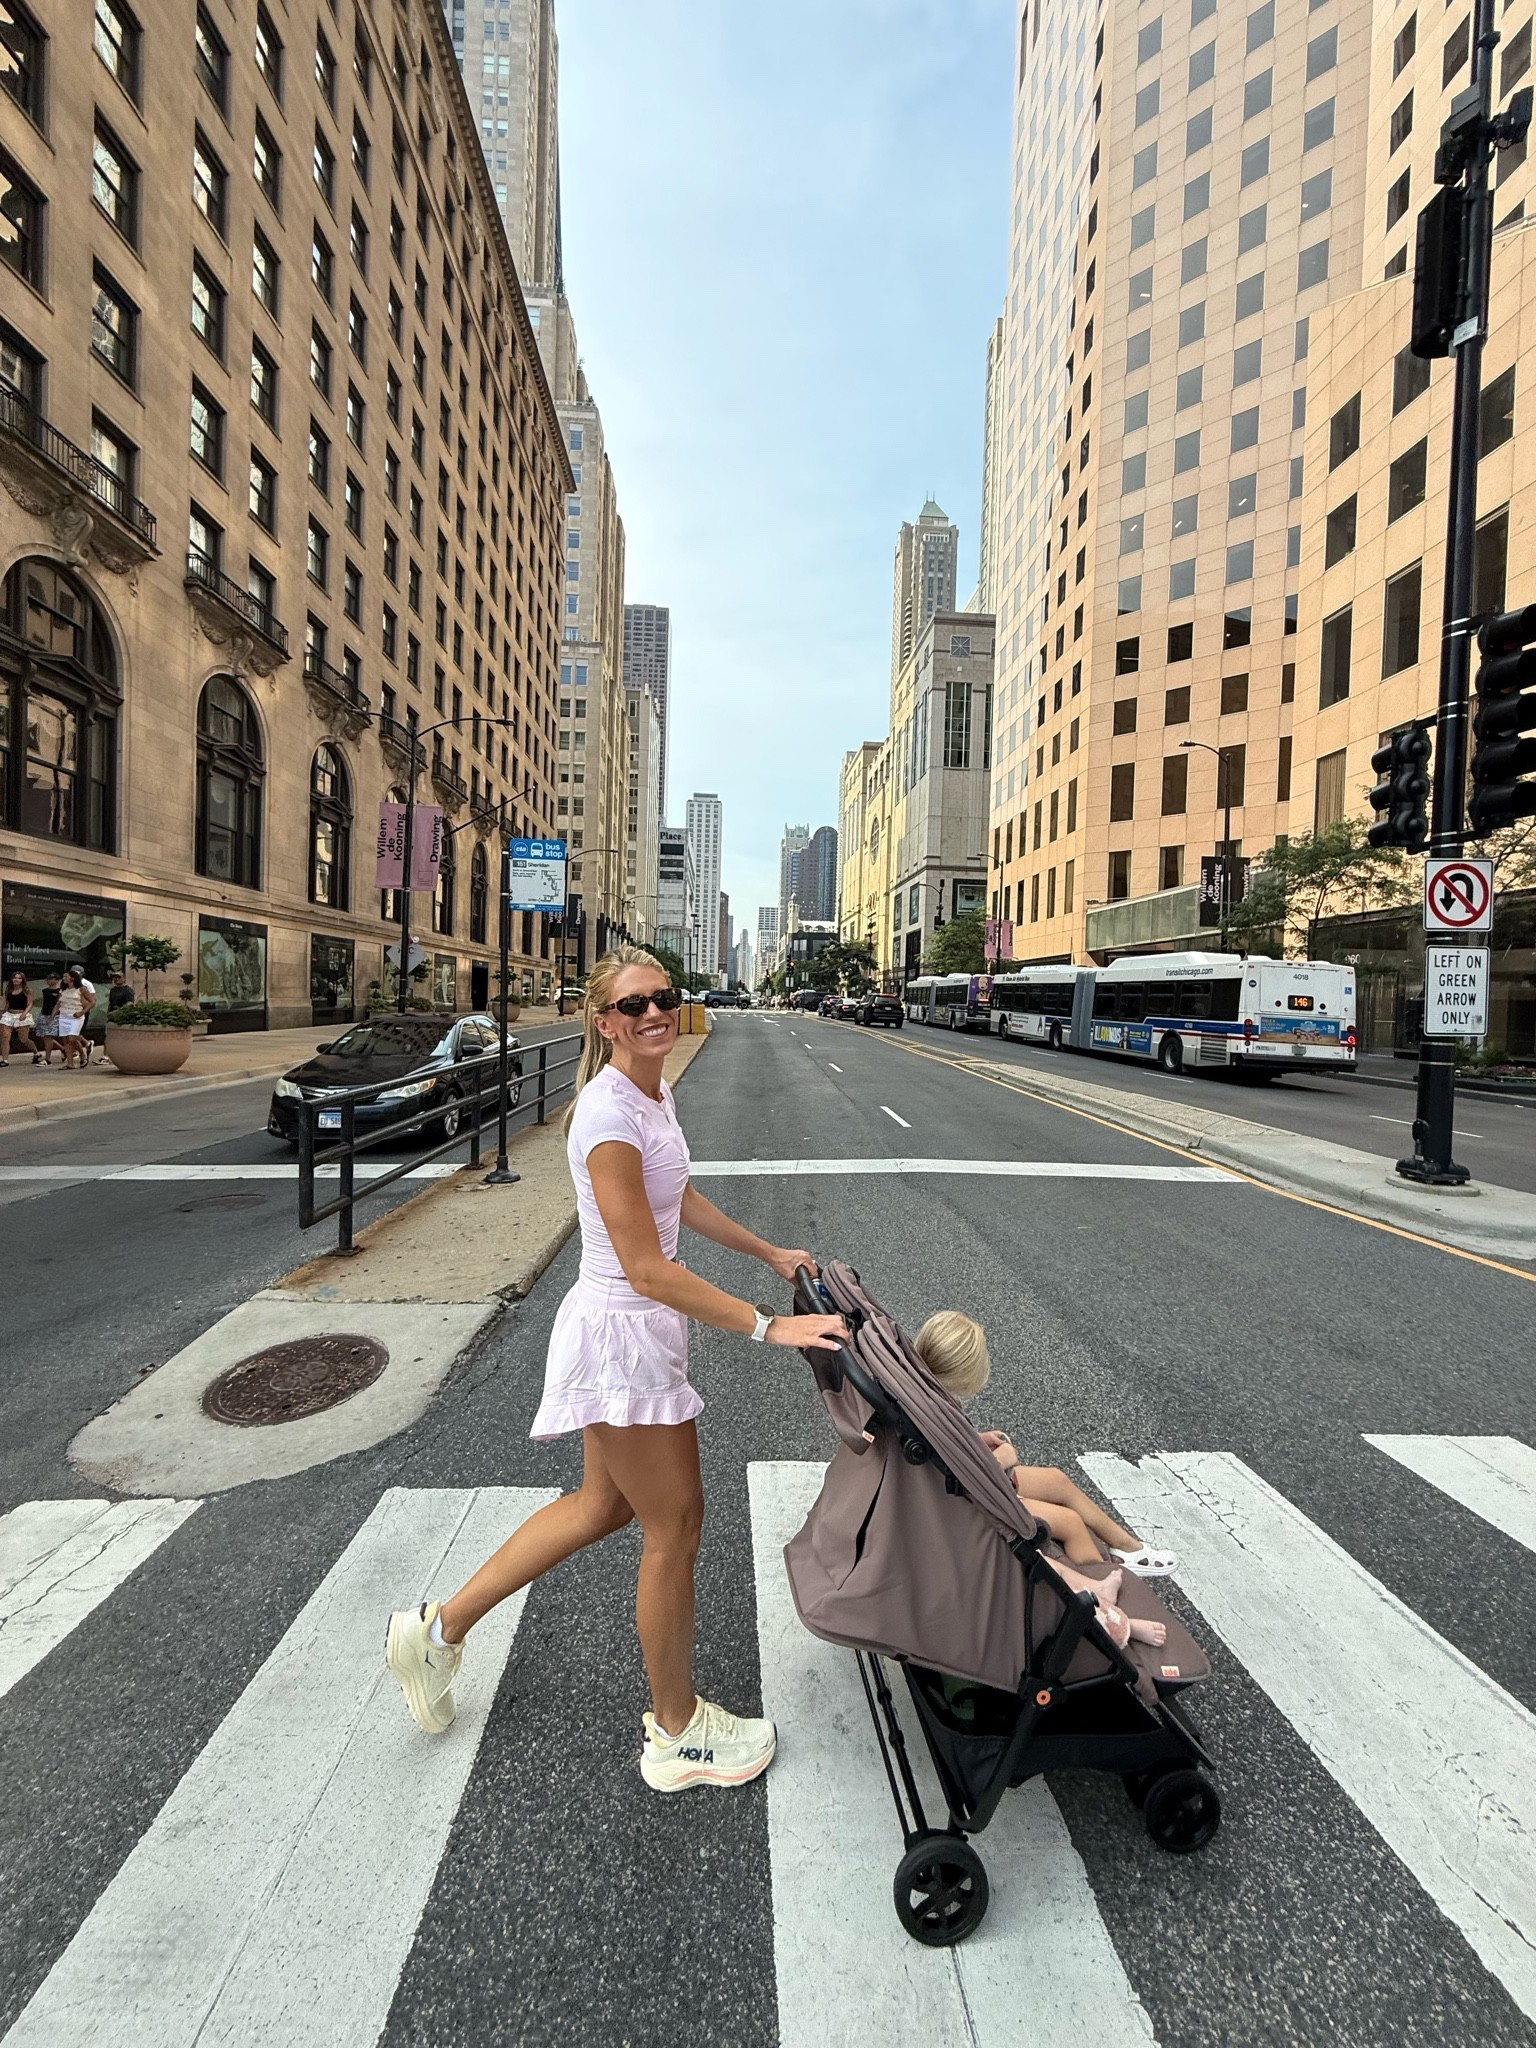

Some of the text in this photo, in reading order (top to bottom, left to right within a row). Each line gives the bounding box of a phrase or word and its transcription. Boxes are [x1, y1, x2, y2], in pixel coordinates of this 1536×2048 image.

[377, 817, 388, 859] Willem
[393, 812, 406, 861] Kooning
[430, 814, 443, 863] Drawing
[660, 831, 682, 840] Place
[388, 837, 395, 853] de
[545, 843, 560, 851] bus
[545, 850, 563, 859] stop
[1200, 868, 1208, 903] Willem
[1207, 884, 1214, 897] de
[1212, 863, 1222, 904] Kooning
[1241, 863, 1251, 904] Drawing
[24, 943, 50, 954] Perfect
[6, 955, 26, 964] Bowl
[1434, 954, 1482, 969] LEFT ON
[1165, 967, 1214, 978] transitchicago.com
[1293, 973, 1309, 981] 4018
[1439, 973, 1476, 987] GREEN
[1293, 997, 1308, 1007] 146
[1437, 992, 1477, 1006] ARROW
[1442, 1011, 1470, 1025] ONLY
